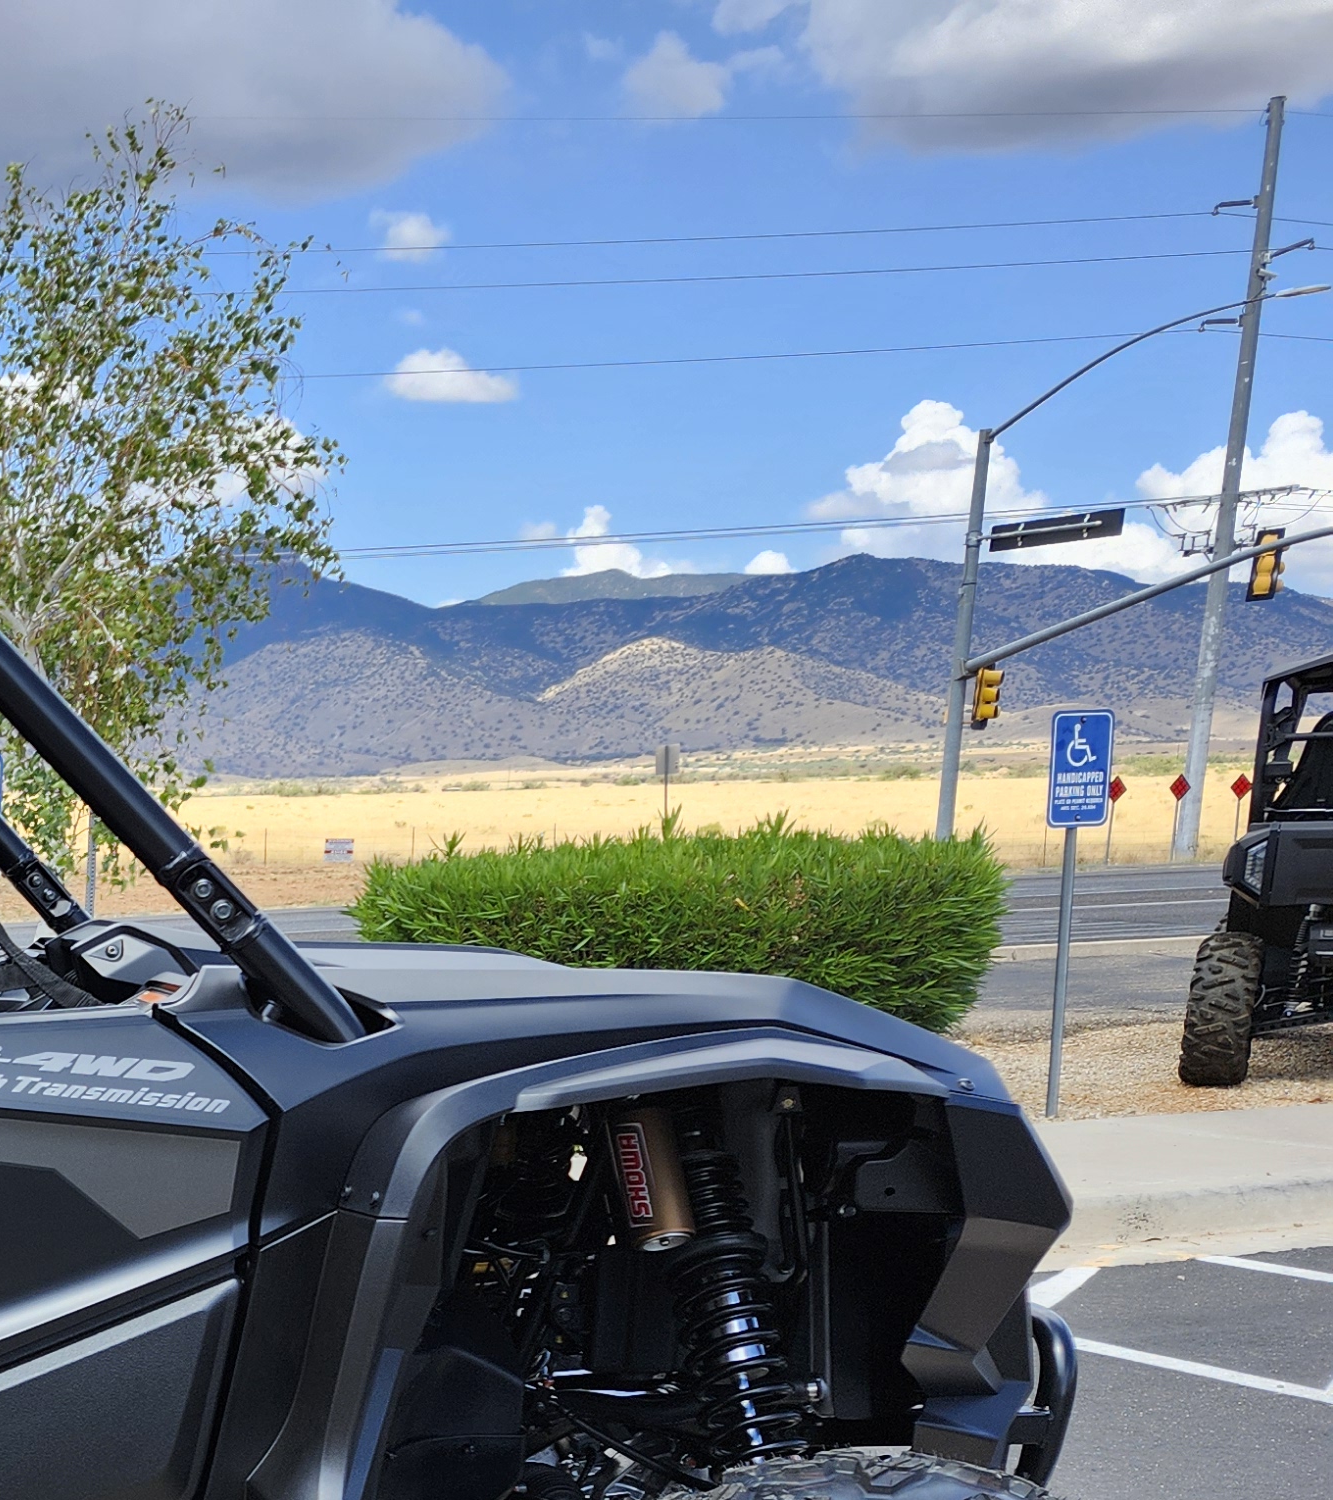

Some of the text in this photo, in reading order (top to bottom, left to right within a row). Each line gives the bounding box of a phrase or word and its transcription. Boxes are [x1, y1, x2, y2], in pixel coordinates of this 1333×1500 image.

[1056, 771, 1104, 784] HANDICAPPED
[1055, 784, 1104, 797] PARKING ONLY
[10, 1075, 231, 1113] Transmission
[616, 1132, 653, 1218] SHOWA
